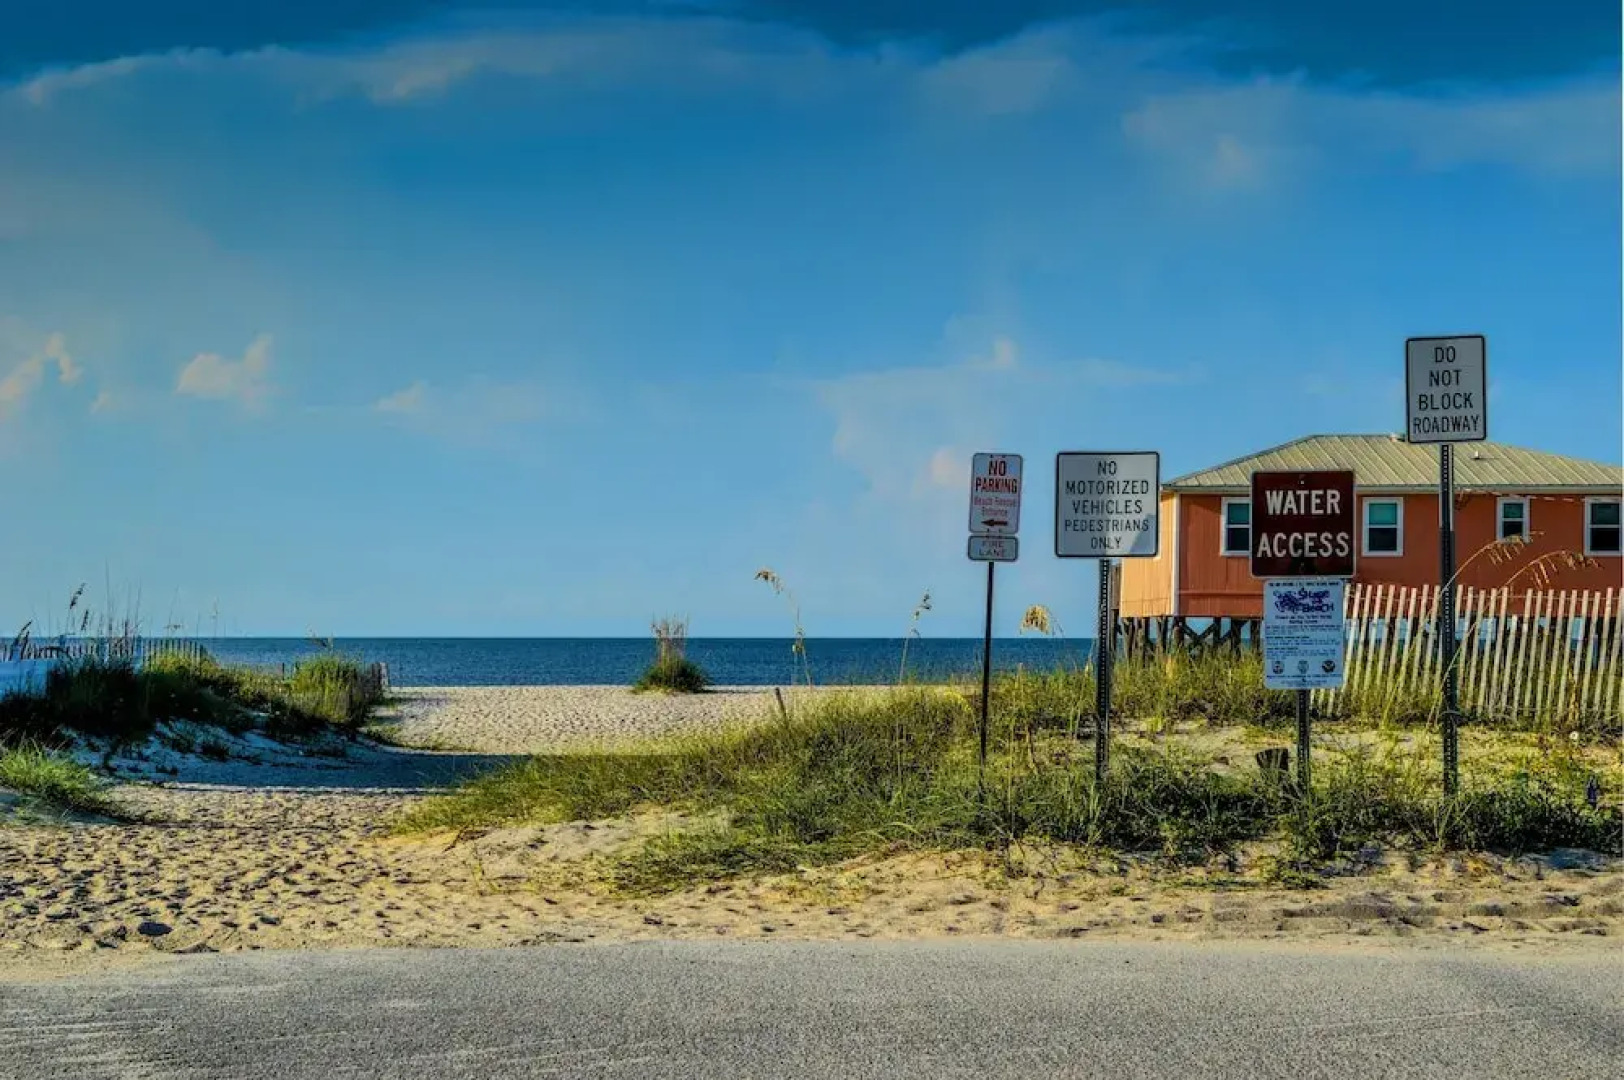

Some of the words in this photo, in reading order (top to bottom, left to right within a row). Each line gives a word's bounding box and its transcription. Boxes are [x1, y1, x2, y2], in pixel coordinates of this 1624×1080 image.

[1434, 346, 1456, 363] DO
[1429, 369, 1462, 387] NOT
[1418, 393, 1473, 411] BLOCK
[1413, 415, 1479, 434] ROADWAY
[988, 460, 1006, 476] NO
[1097, 461, 1117, 476] NO
[975, 477, 1018, 494] PARKING
[1065, 480, 1149, 495] MOTORIZED
[1072, 500, 1142, 515] VEHICLES
[1265, 489, 1341, 515] WATER
[1064, 519, 1149, 532] PEDESTRIANS
[1091, 537, 1122, 550] ONLY
[1257, 531, 1349, 558] ACCESS
[979, 549, 1006, 557] LANE
